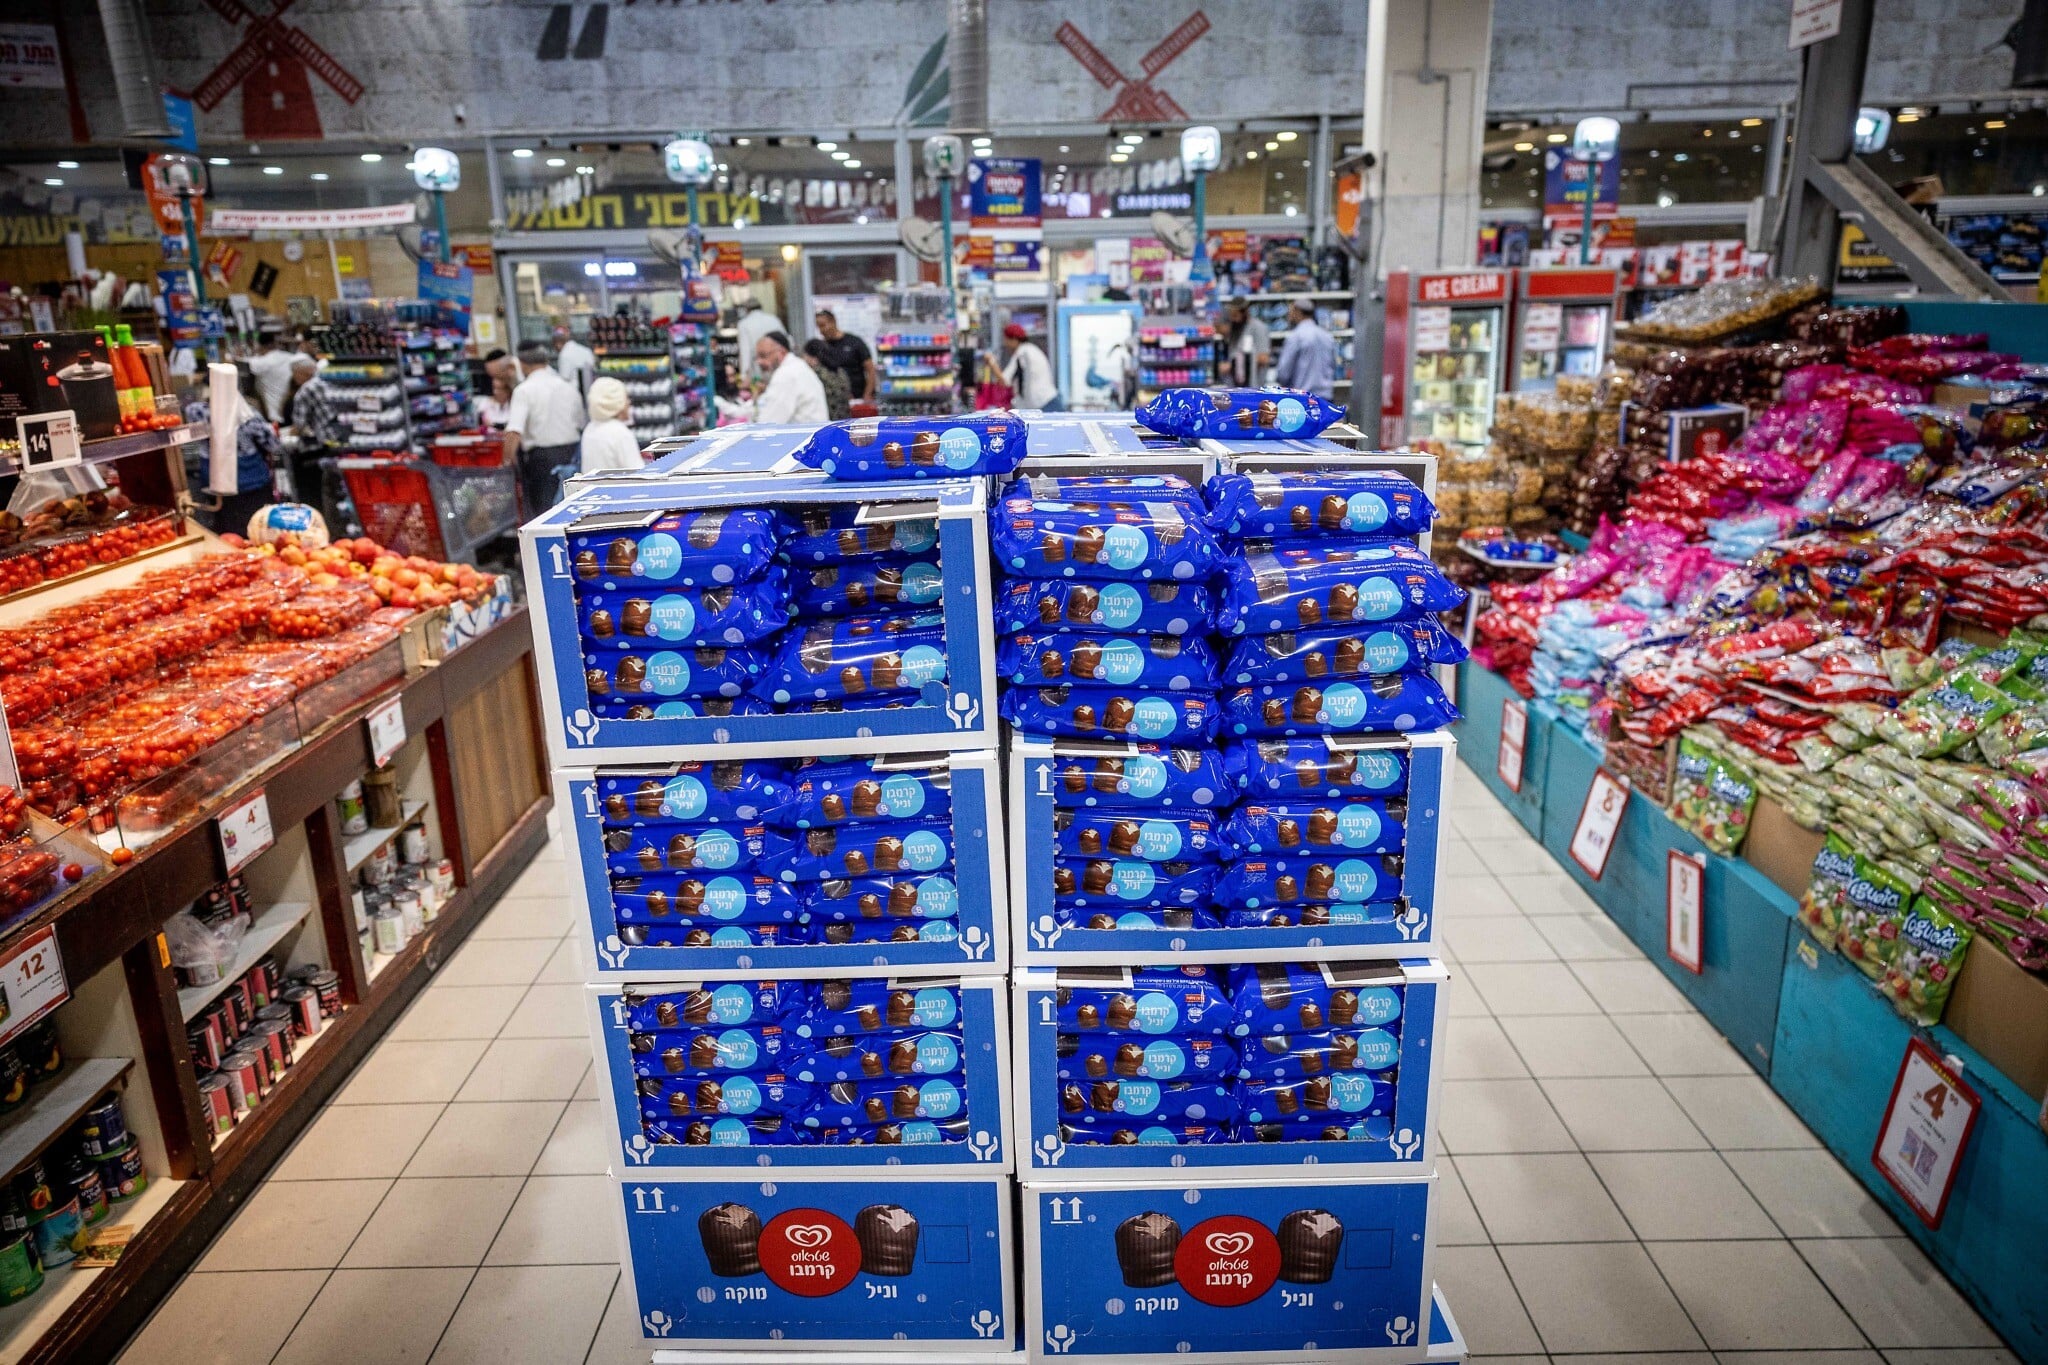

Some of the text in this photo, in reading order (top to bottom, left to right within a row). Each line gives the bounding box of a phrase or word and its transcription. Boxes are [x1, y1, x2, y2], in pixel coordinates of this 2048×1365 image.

[1117, 193, 1192, 210] SAMSUNG
[633, 193, 762, 226] מחסני
[1424, 274, 1499, 299] ICE CREAM
[30, 433, 48, 453] 14
[942, 438, 974, 452] קרמבו
[950, 450, 967, 460] וניל
[1352, 504, 1380, 517] קרמבו
[1358, 513, 1374, 524] וניל
[1110, 536, 1140, 550] קרמבו
[642, 548, 672, 558] קרמבו
[1116, 548, 1134, 560] וניל
[650, 558, 667, 568] וניל
[1104, 596, 1134, 608] קרמבו
[1371, 601, 1388, 612] וניל
[656, 608, 686, 620] קרמבו
[1110, 607, 1127, 618] וניל
[664, 618, 681, 630] וניל
[1370, 646, 1398, 658] קרמבו
[906, 658, 937, 670] קרמבו
[1106, 654, 1136, 664] קרמבו
[1376, 656, 1394, 667] וניל
[651, 666, 681, 676] קרמבו
[1112, 663, 1129, 674] וניל
[658, 675, 676, 686] וניל
[915, 670, 932, 680] וניל
[1328, 696, 1358, 707] קרמבו
[1138, 710, 1168, 722] קרמבו
[1335, 706, 1354, 718] וניל
[1144, 720, 1161, 731] וניל
[1130, 766, 1158, 777] קרמבו
[1136, 777, 1153, 788] וניל
[670, 788, 698, 800] קרמבו
[886, 786, 916, 798] קרמבו
[894, 798, 912, 808] וניל
[1342, 817, 1372, 828] קרמבו
[1144, 831, 1174, 842] קרמבו
[1350, 827, 1366, 838] וניל
[702, 843, 730, 854] קרמבו
[908, 844, 936, 855] קרמבו
[1150, 841, 1166, 852] וניל
[708, 852, 726, 862] וניל
[916, 854, 933, 863] וניל
[1813, 847, 1857, 876] Yoguet
[1118, 870, 1146, 880] קרמבו
[1340, 872, 1368, 884] קרמבו
[1124, 880, 1140, 890] וניל
[1346, 882, 1363, 893] וניל
[710, 890, 738, 902] קרמבו
[922, 890, 950, 902] קרמבו
[716, 900, 732, 910] וניל
[928, 900, 946, 910] וניל
[20, 952, 45, 980] 12
[716, 997, 744, 1007] קרמבו
[920, 999, 948, 1010] קרמבו
[724, 1006, 739, 1017] וניל
[926, 1008, 942, 1019] וניל
[1142, 1006, 1170, 1018] קרמבו
[1370, 1008, 1387, 1018] וניל
[1148, 1016, 1164, 1026] וניל
[922, 1047, 950, 1058] קרמבו
[1362, 1042, 1391, 1052] קרמבו
[929, 1056, 945, 1066] וניל
[1148, 1054, 1177, 1066] קרמבו
[1370, 1052, 1387, 1062] וניל
[1155, 1063, 1172, 1073] וניל
[1124, 1086, 1152, 1097] קרמבו
[1336, 1082, 1365, 1092] קרמבו
[726, 1088, 753, 1100] קרמבו
[924, 1092, 952, 1103] קרמבו
[1344, 1092, 1361, 1102] וניל
[1130, 1096, 1146, 1106] וניל
[1924, 1082, 1948, 1121] 4
[932, 1102, 948, 1112] וניל
[716, 1130, 742, 1140] קרמבו
[906, 1131, 934, 1142] קרמבו
[791, 1248, 830, 1263] שטראוס
[1208, 1257, 1249, 1272] שטראוס
[789, 1264, 836, 1280] קרמבו
[1206, 1271, 1254, 1288] קרמבו
[724, 1286, 767, 1305] מוקה
[865, 1281, 898, 1299] וניל
[1281, 1289, 1314, 1308] וניל
[1134, 1297, 1179, 1316] מוקה
